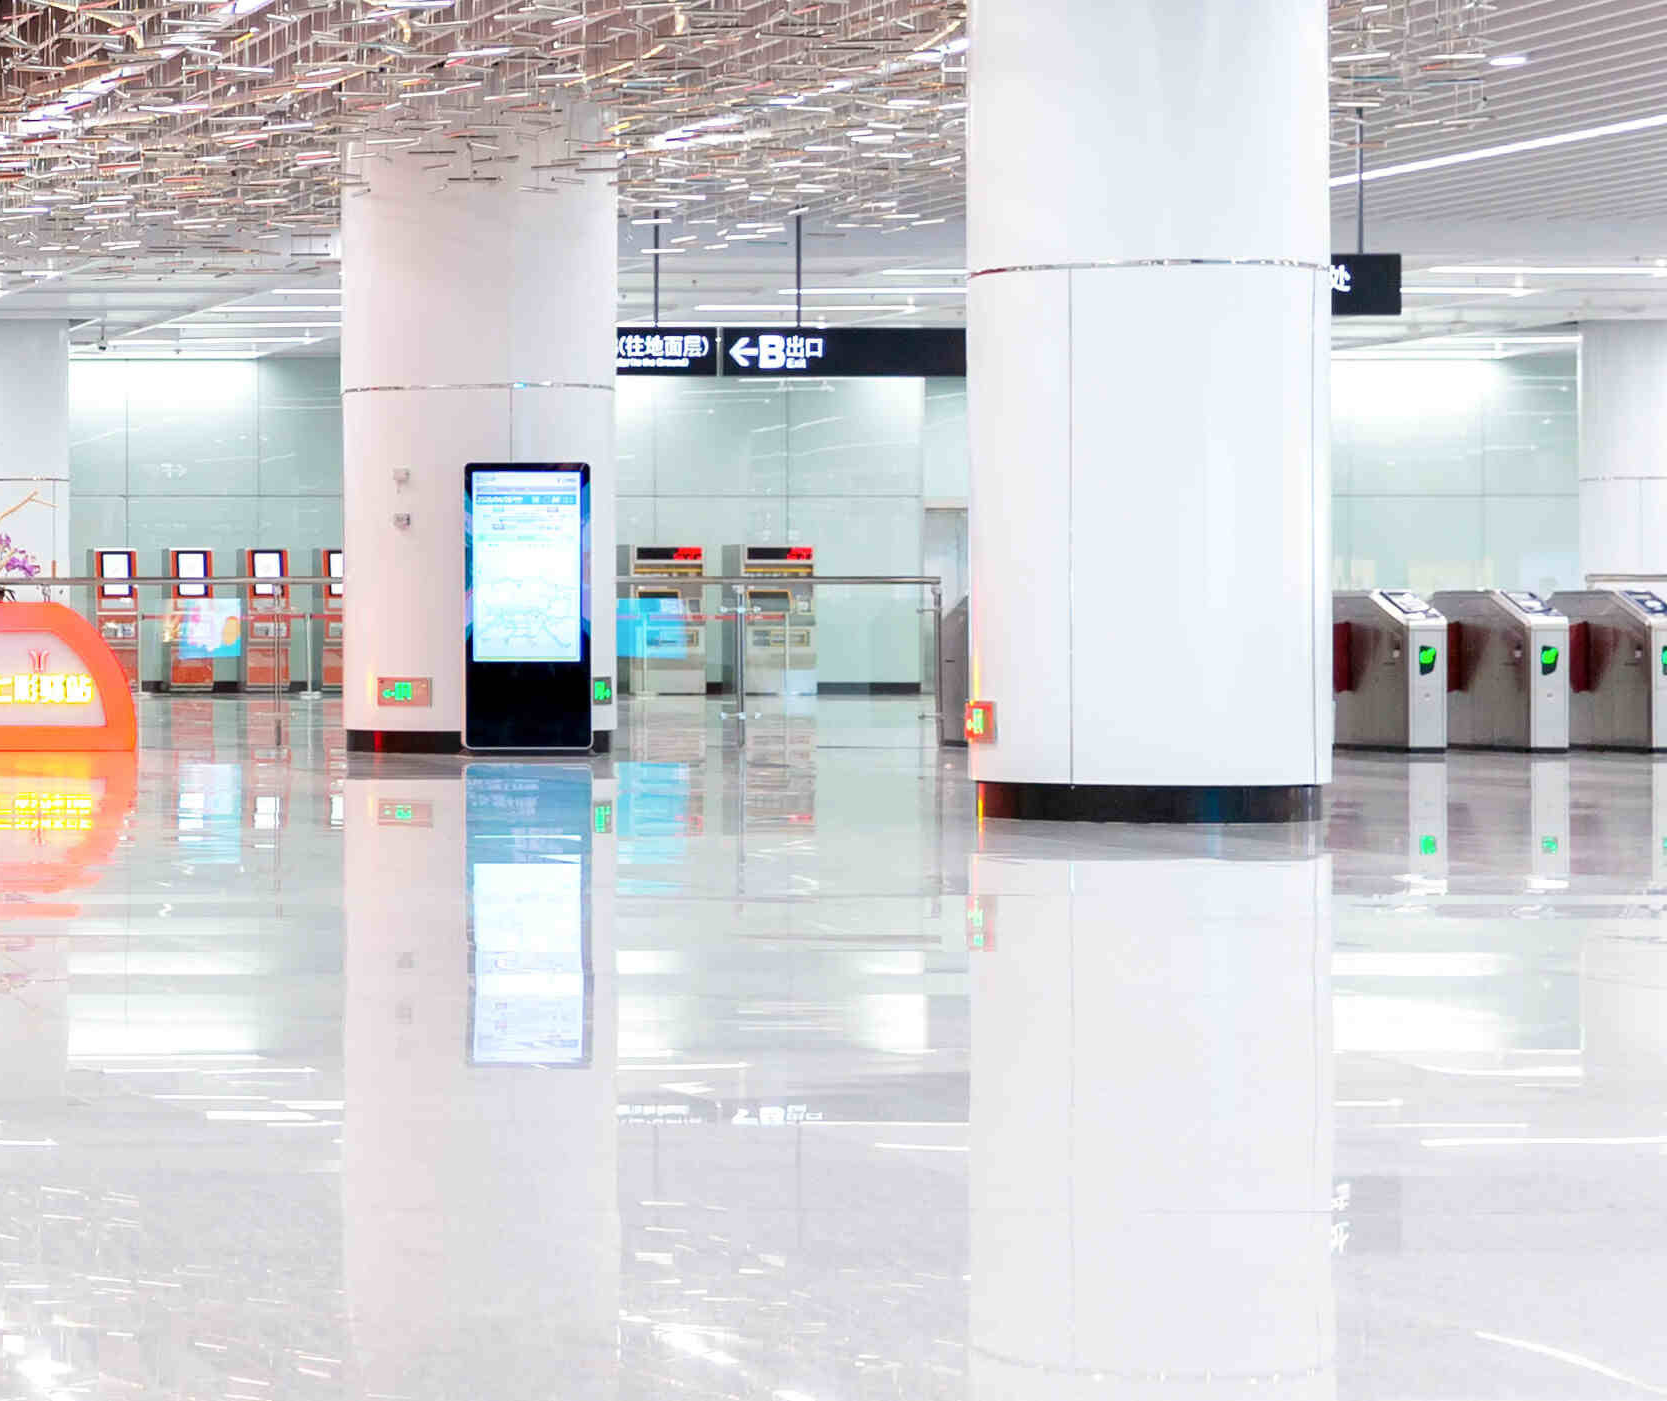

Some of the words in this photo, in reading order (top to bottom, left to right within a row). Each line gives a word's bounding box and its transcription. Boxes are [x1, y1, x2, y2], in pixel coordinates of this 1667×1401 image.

[757, 335, 787, 369] B
[786, 335, 824, 358] 出口
[786, 357, 807, 369] Exit
